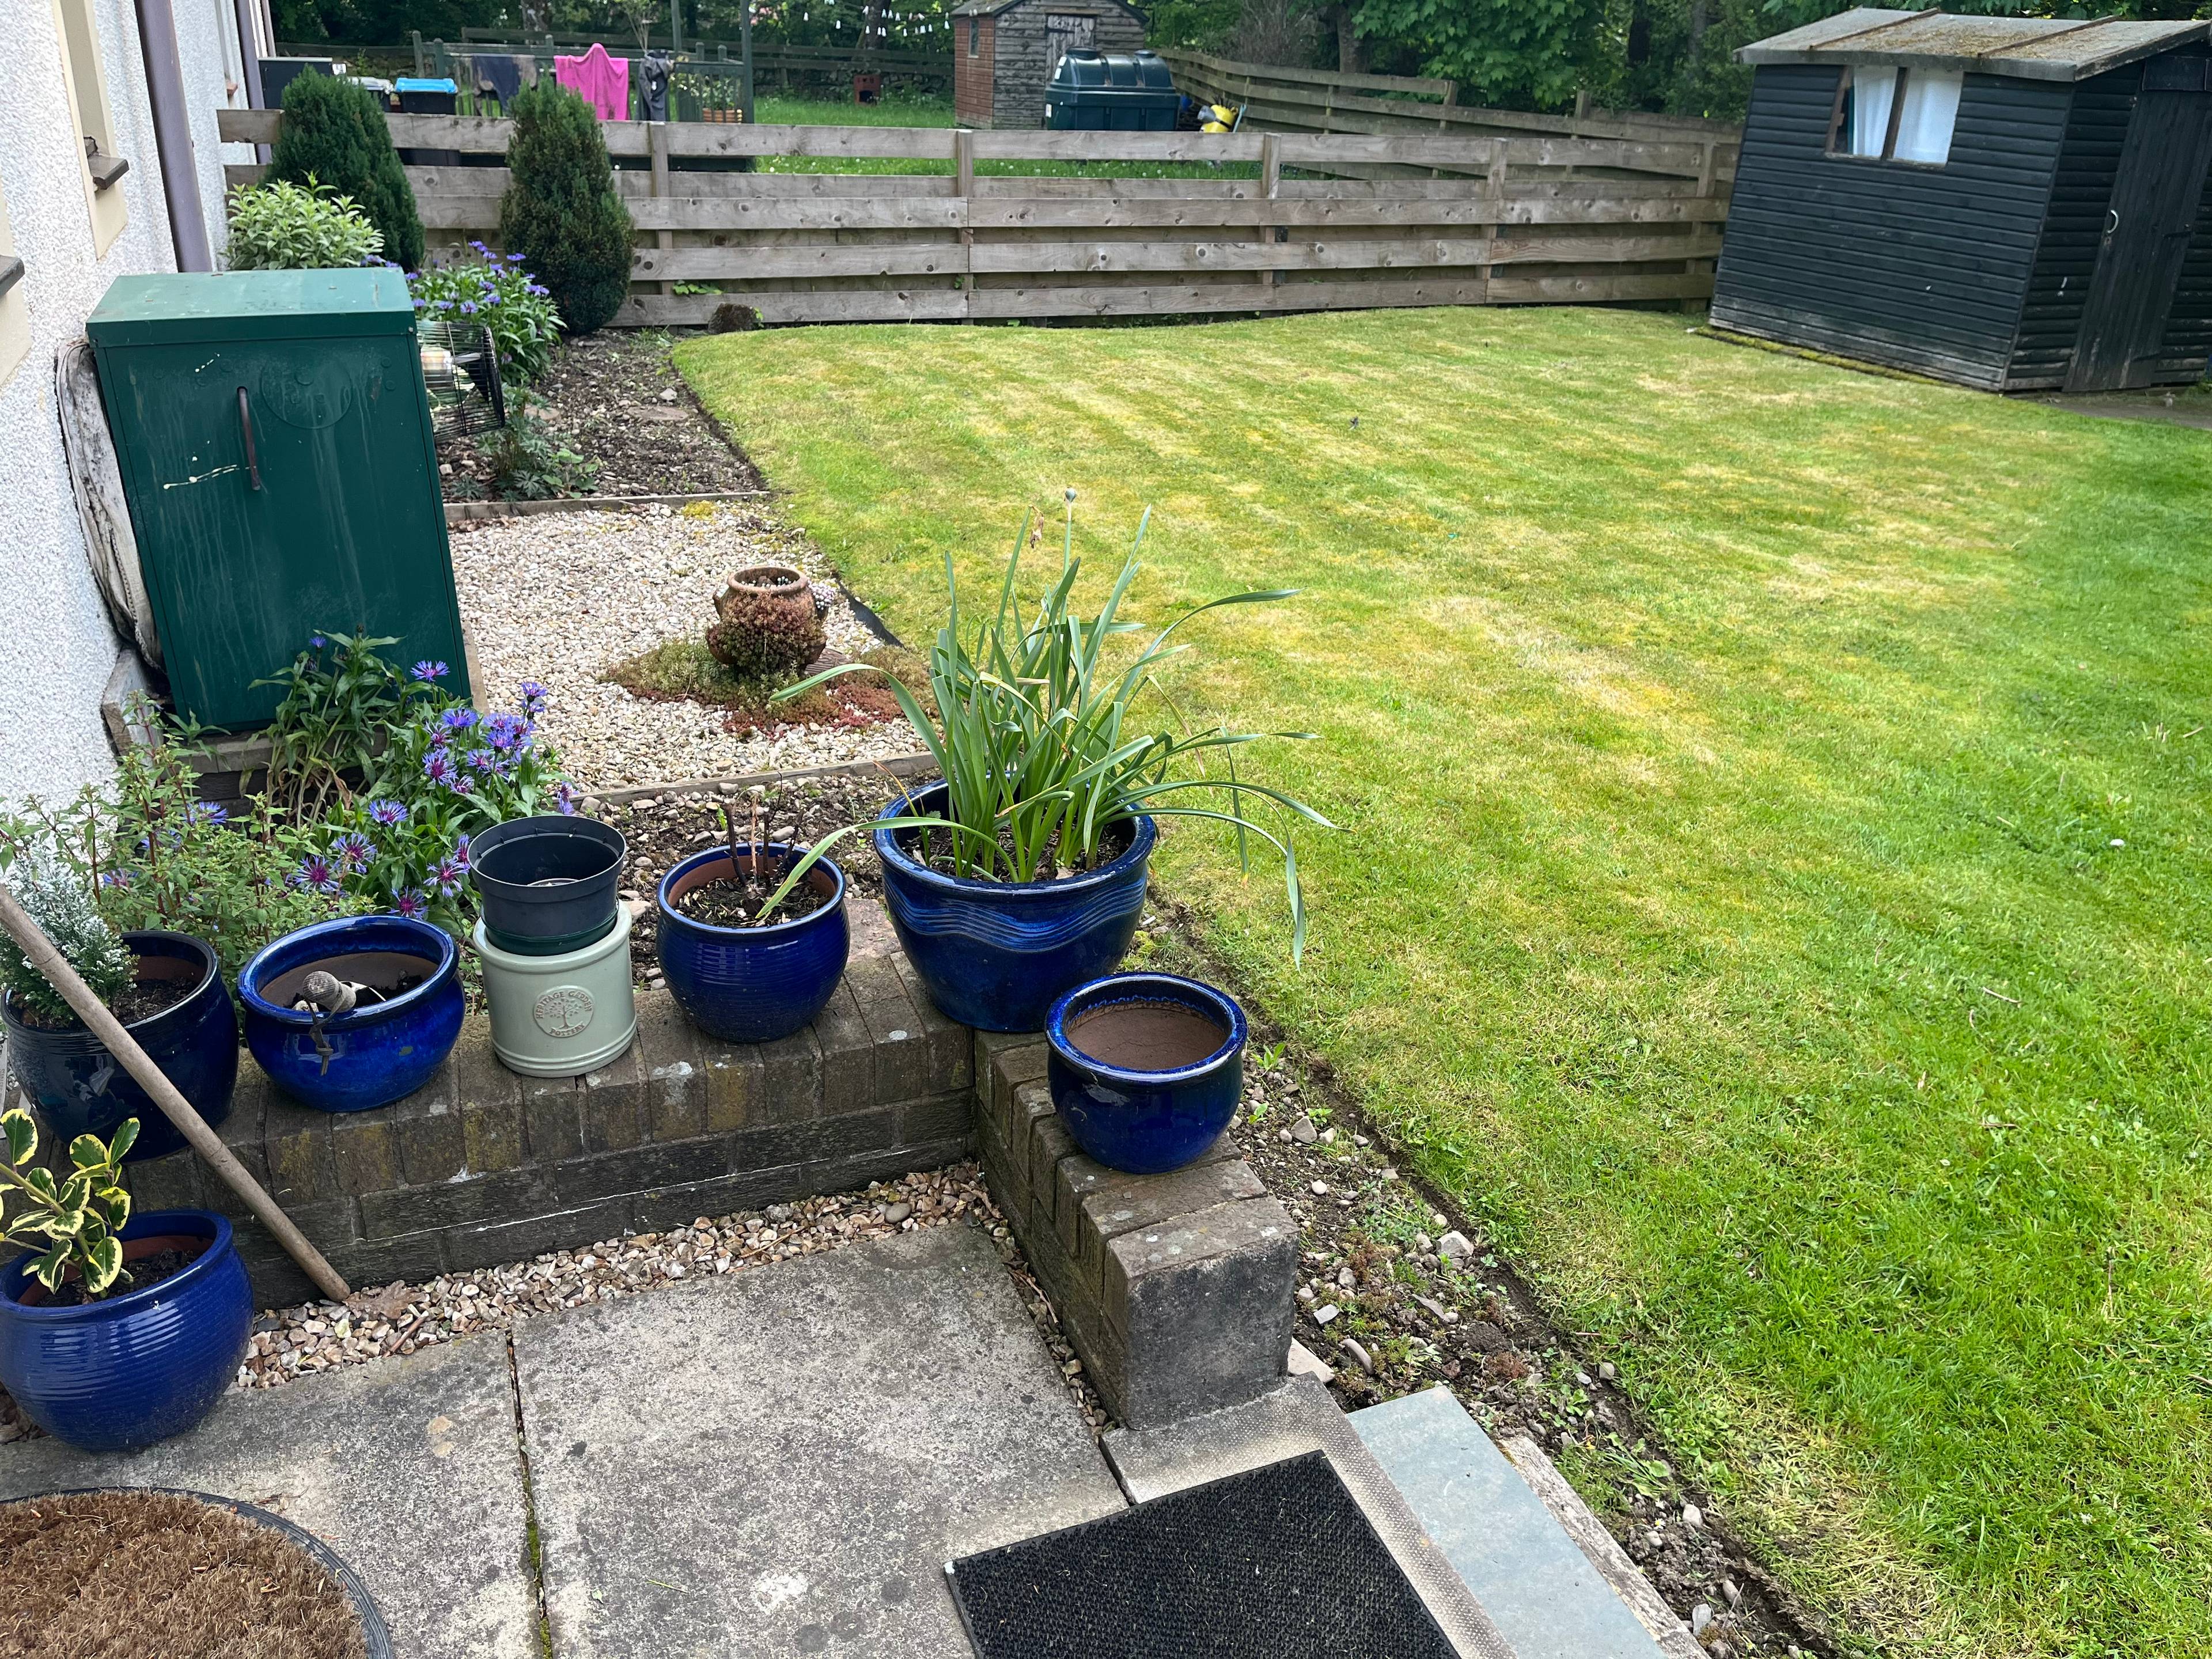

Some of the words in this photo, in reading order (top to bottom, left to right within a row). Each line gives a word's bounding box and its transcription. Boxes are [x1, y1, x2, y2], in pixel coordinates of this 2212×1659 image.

[536, 991, 565, 1019] HERITAGE
[568, 991, 592, 1012] GARDEN
[549, 1023, 585, 1036] POTTERY
